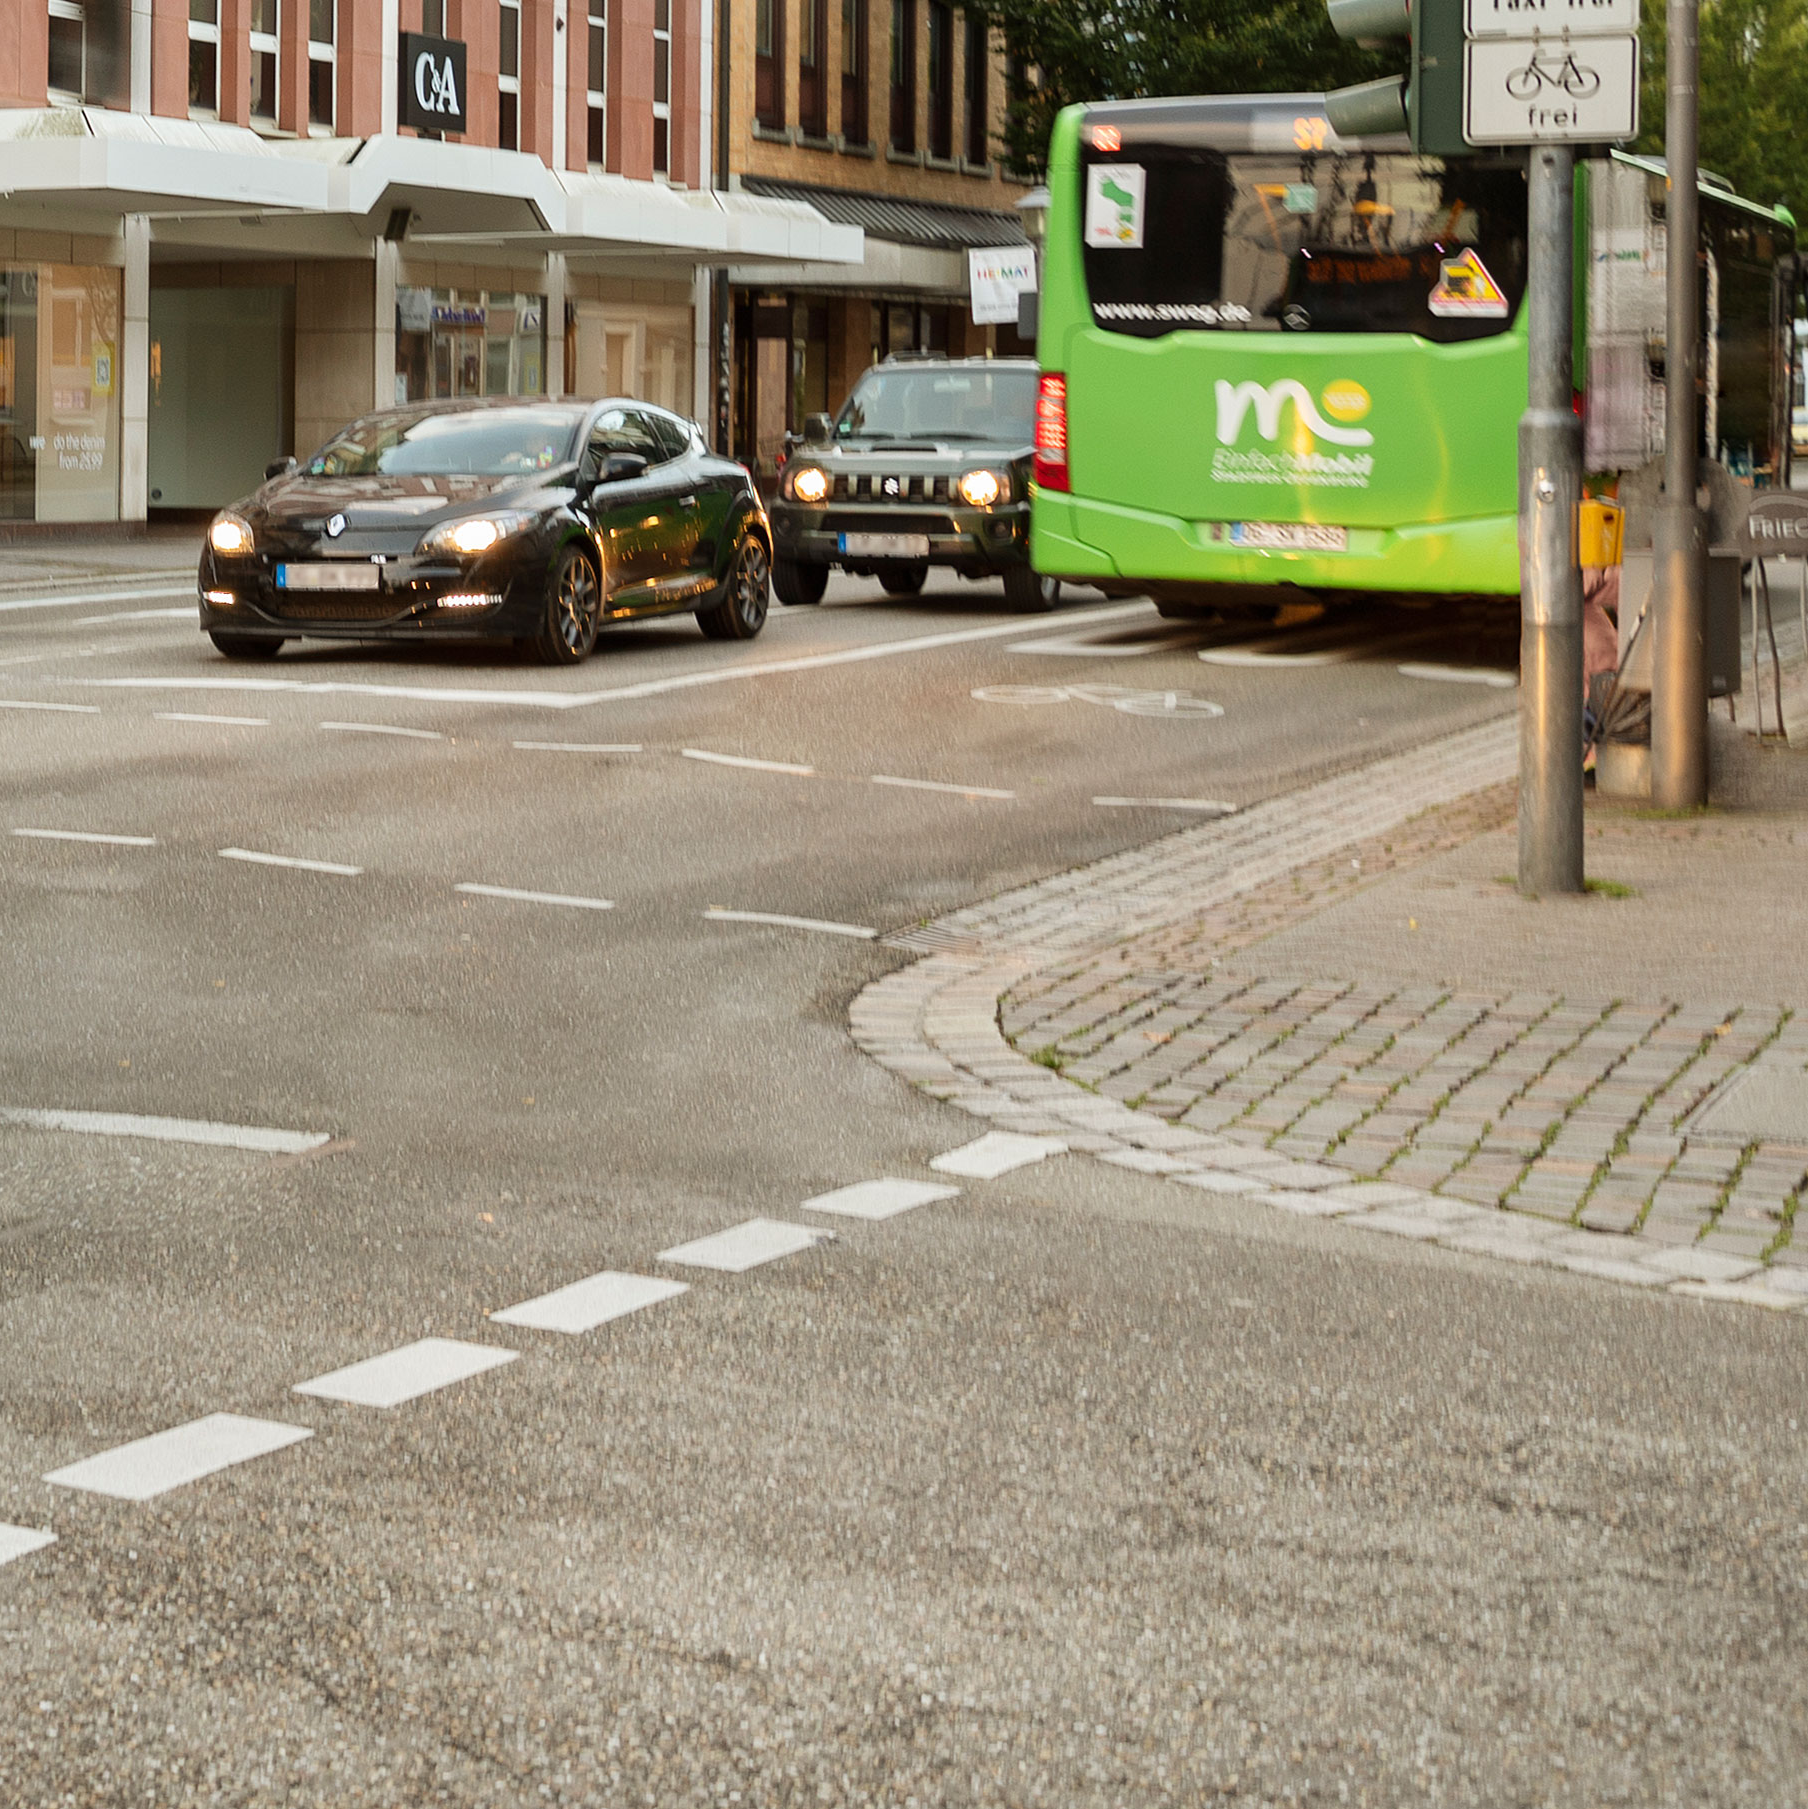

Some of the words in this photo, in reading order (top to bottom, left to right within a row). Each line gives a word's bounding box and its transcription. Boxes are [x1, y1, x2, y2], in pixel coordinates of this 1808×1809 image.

[414, 51, 461, 116] C&A
[1528, 103, 1578, 127] frei
[976, 265, 1029, 281] HEIMAT
[1092, 300, 1253, 325] www.sweg.de
[53, 432, 65, 450] do
[66, 432, 79, 450] the
